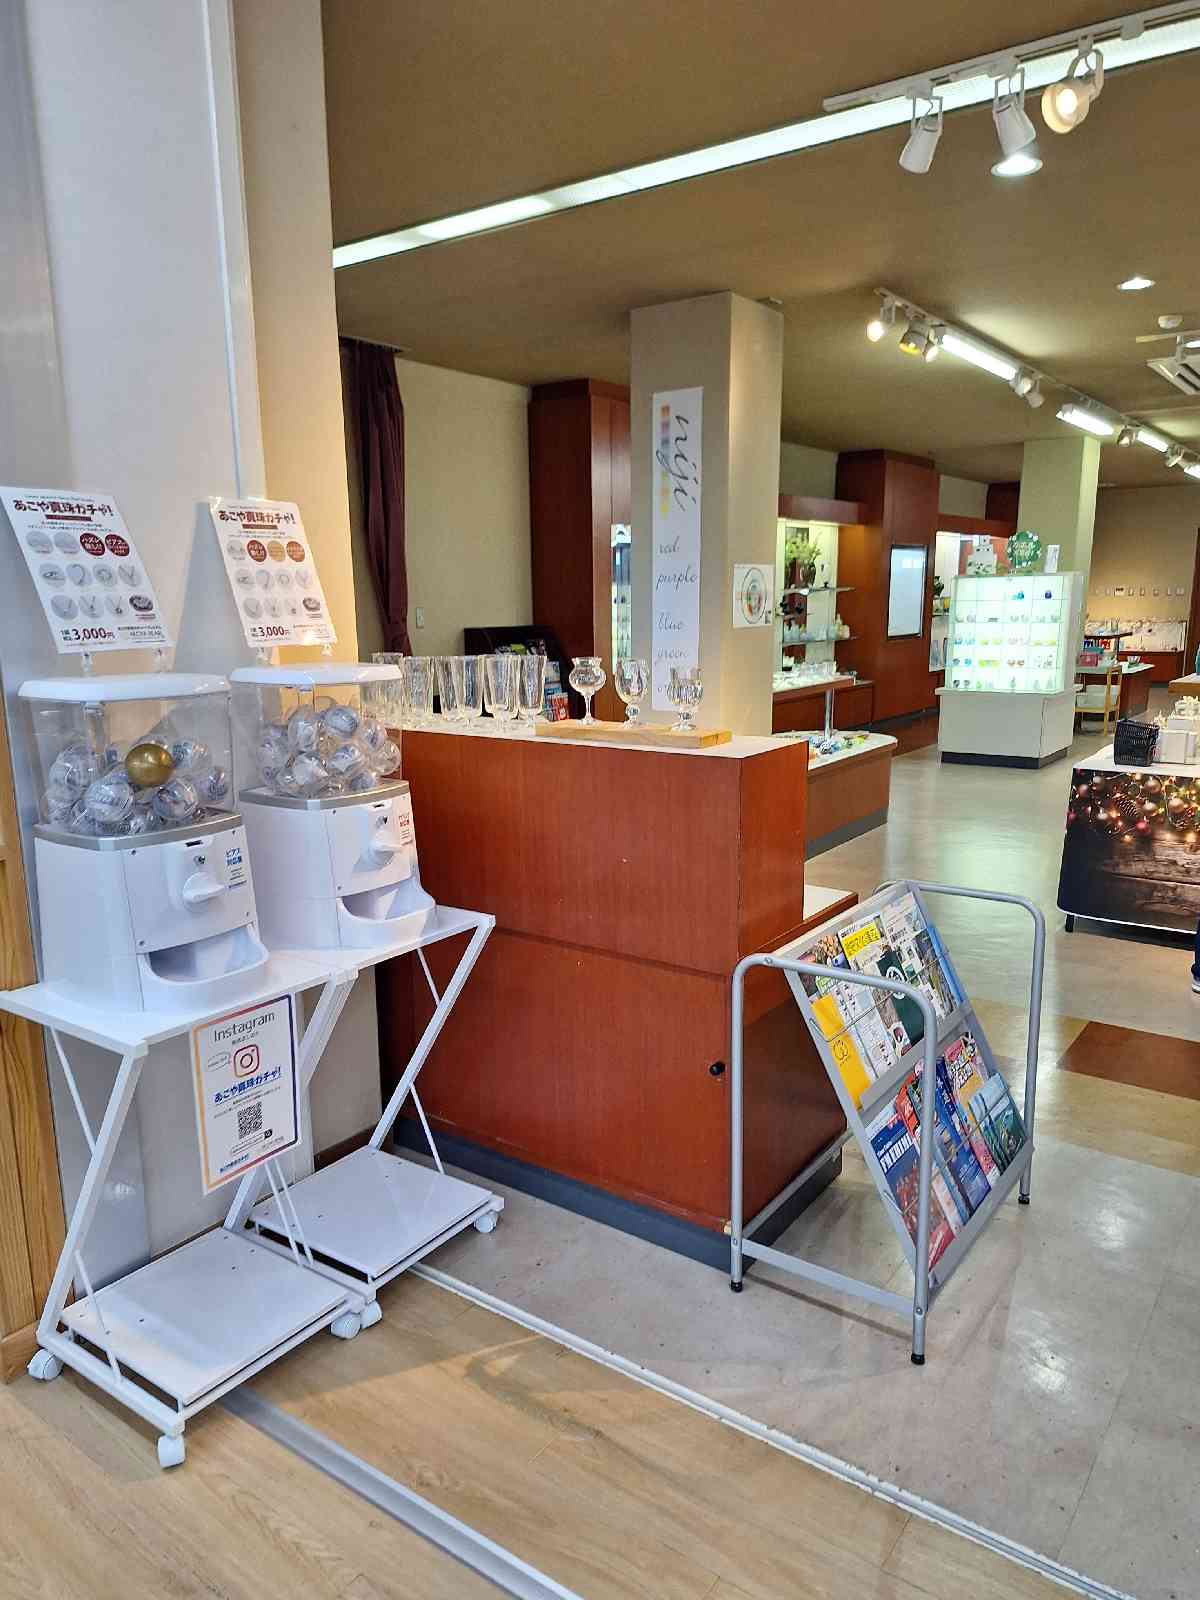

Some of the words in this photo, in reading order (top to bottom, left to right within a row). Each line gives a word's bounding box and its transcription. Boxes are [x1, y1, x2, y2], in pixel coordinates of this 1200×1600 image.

[656, 564, 697, 590] purple
[658, 612, 684, 631] blue
[214, 1011, 275, 1042] Instagram
